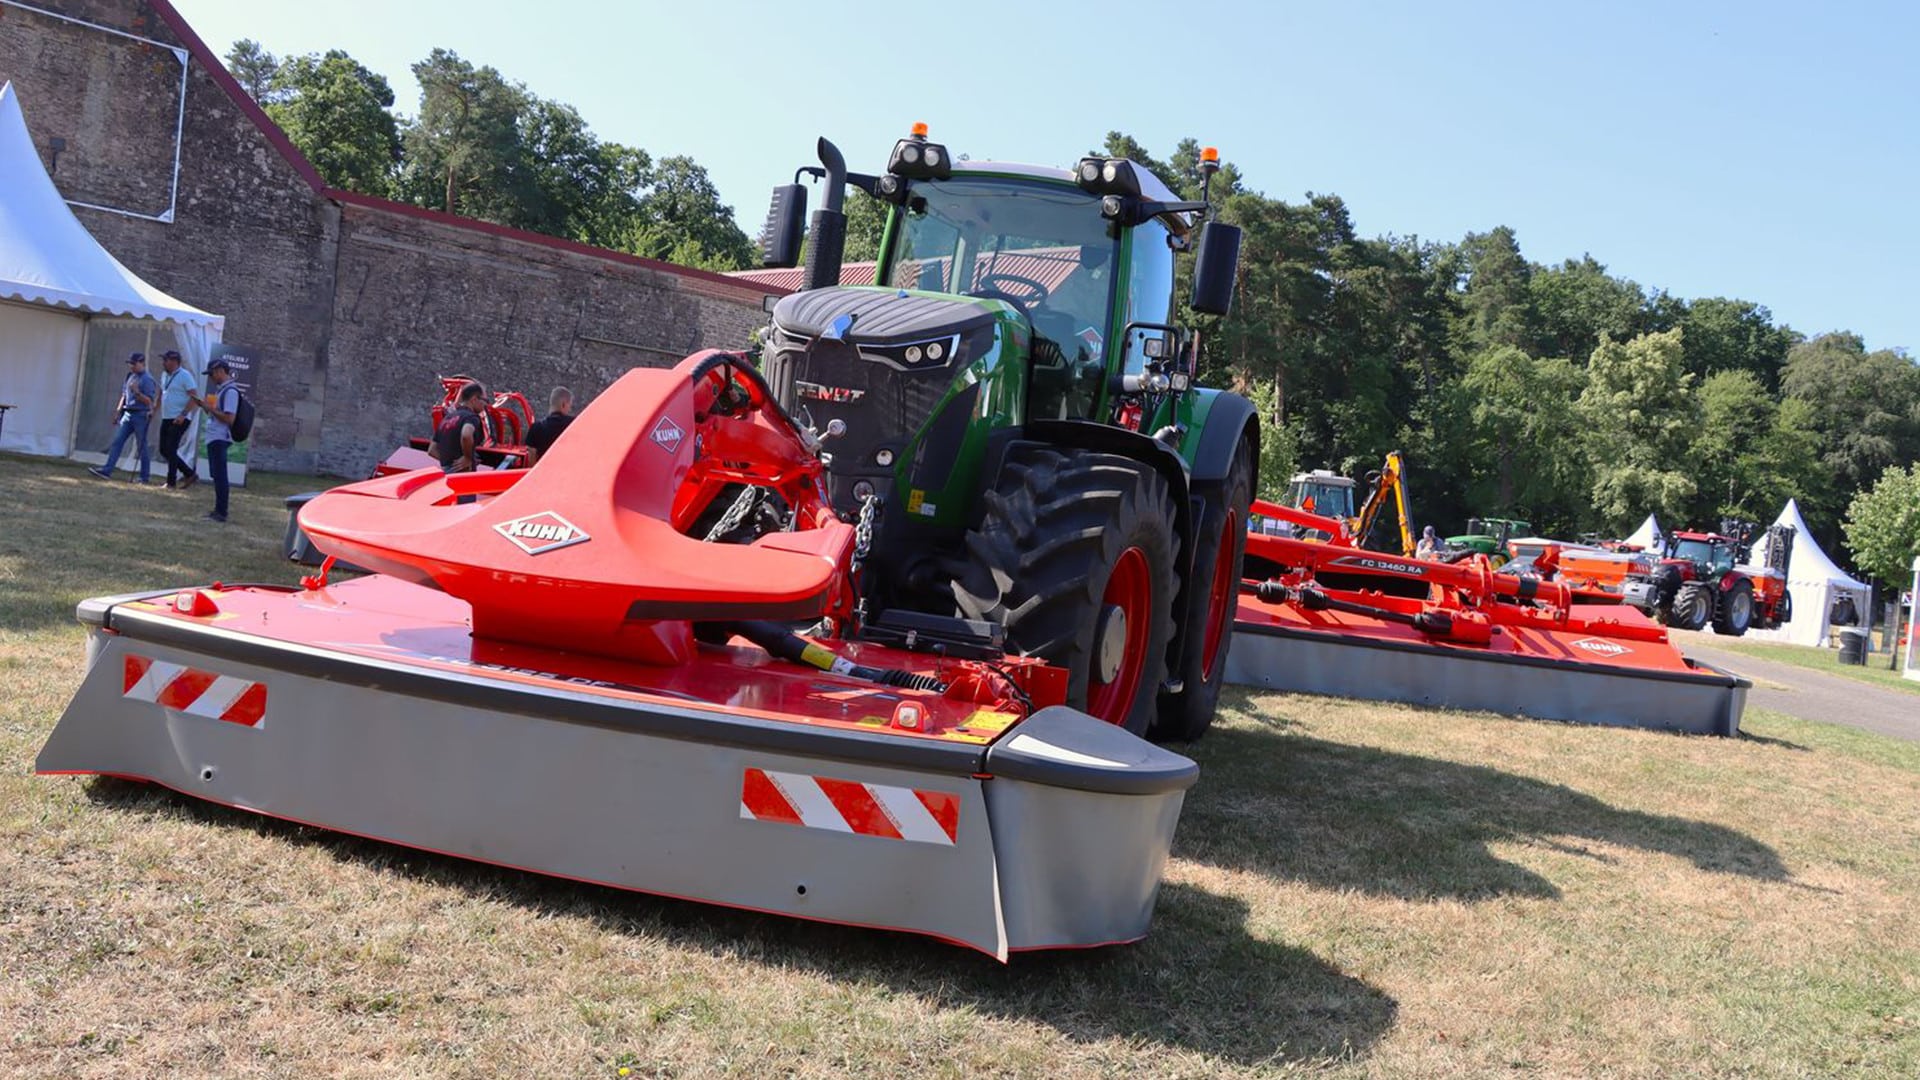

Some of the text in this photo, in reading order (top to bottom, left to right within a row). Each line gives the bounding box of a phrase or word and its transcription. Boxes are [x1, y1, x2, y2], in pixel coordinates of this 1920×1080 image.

[795, 380, 865, 402] FENDT
[655, 428, 680, 442] KUHN
[509, 519, 573, 542] KUHN
[1361, 559, 1375, 567] FC
[1407, 566, 1422, 574] RA
[1580, 641, 1623, 653] KUHN
